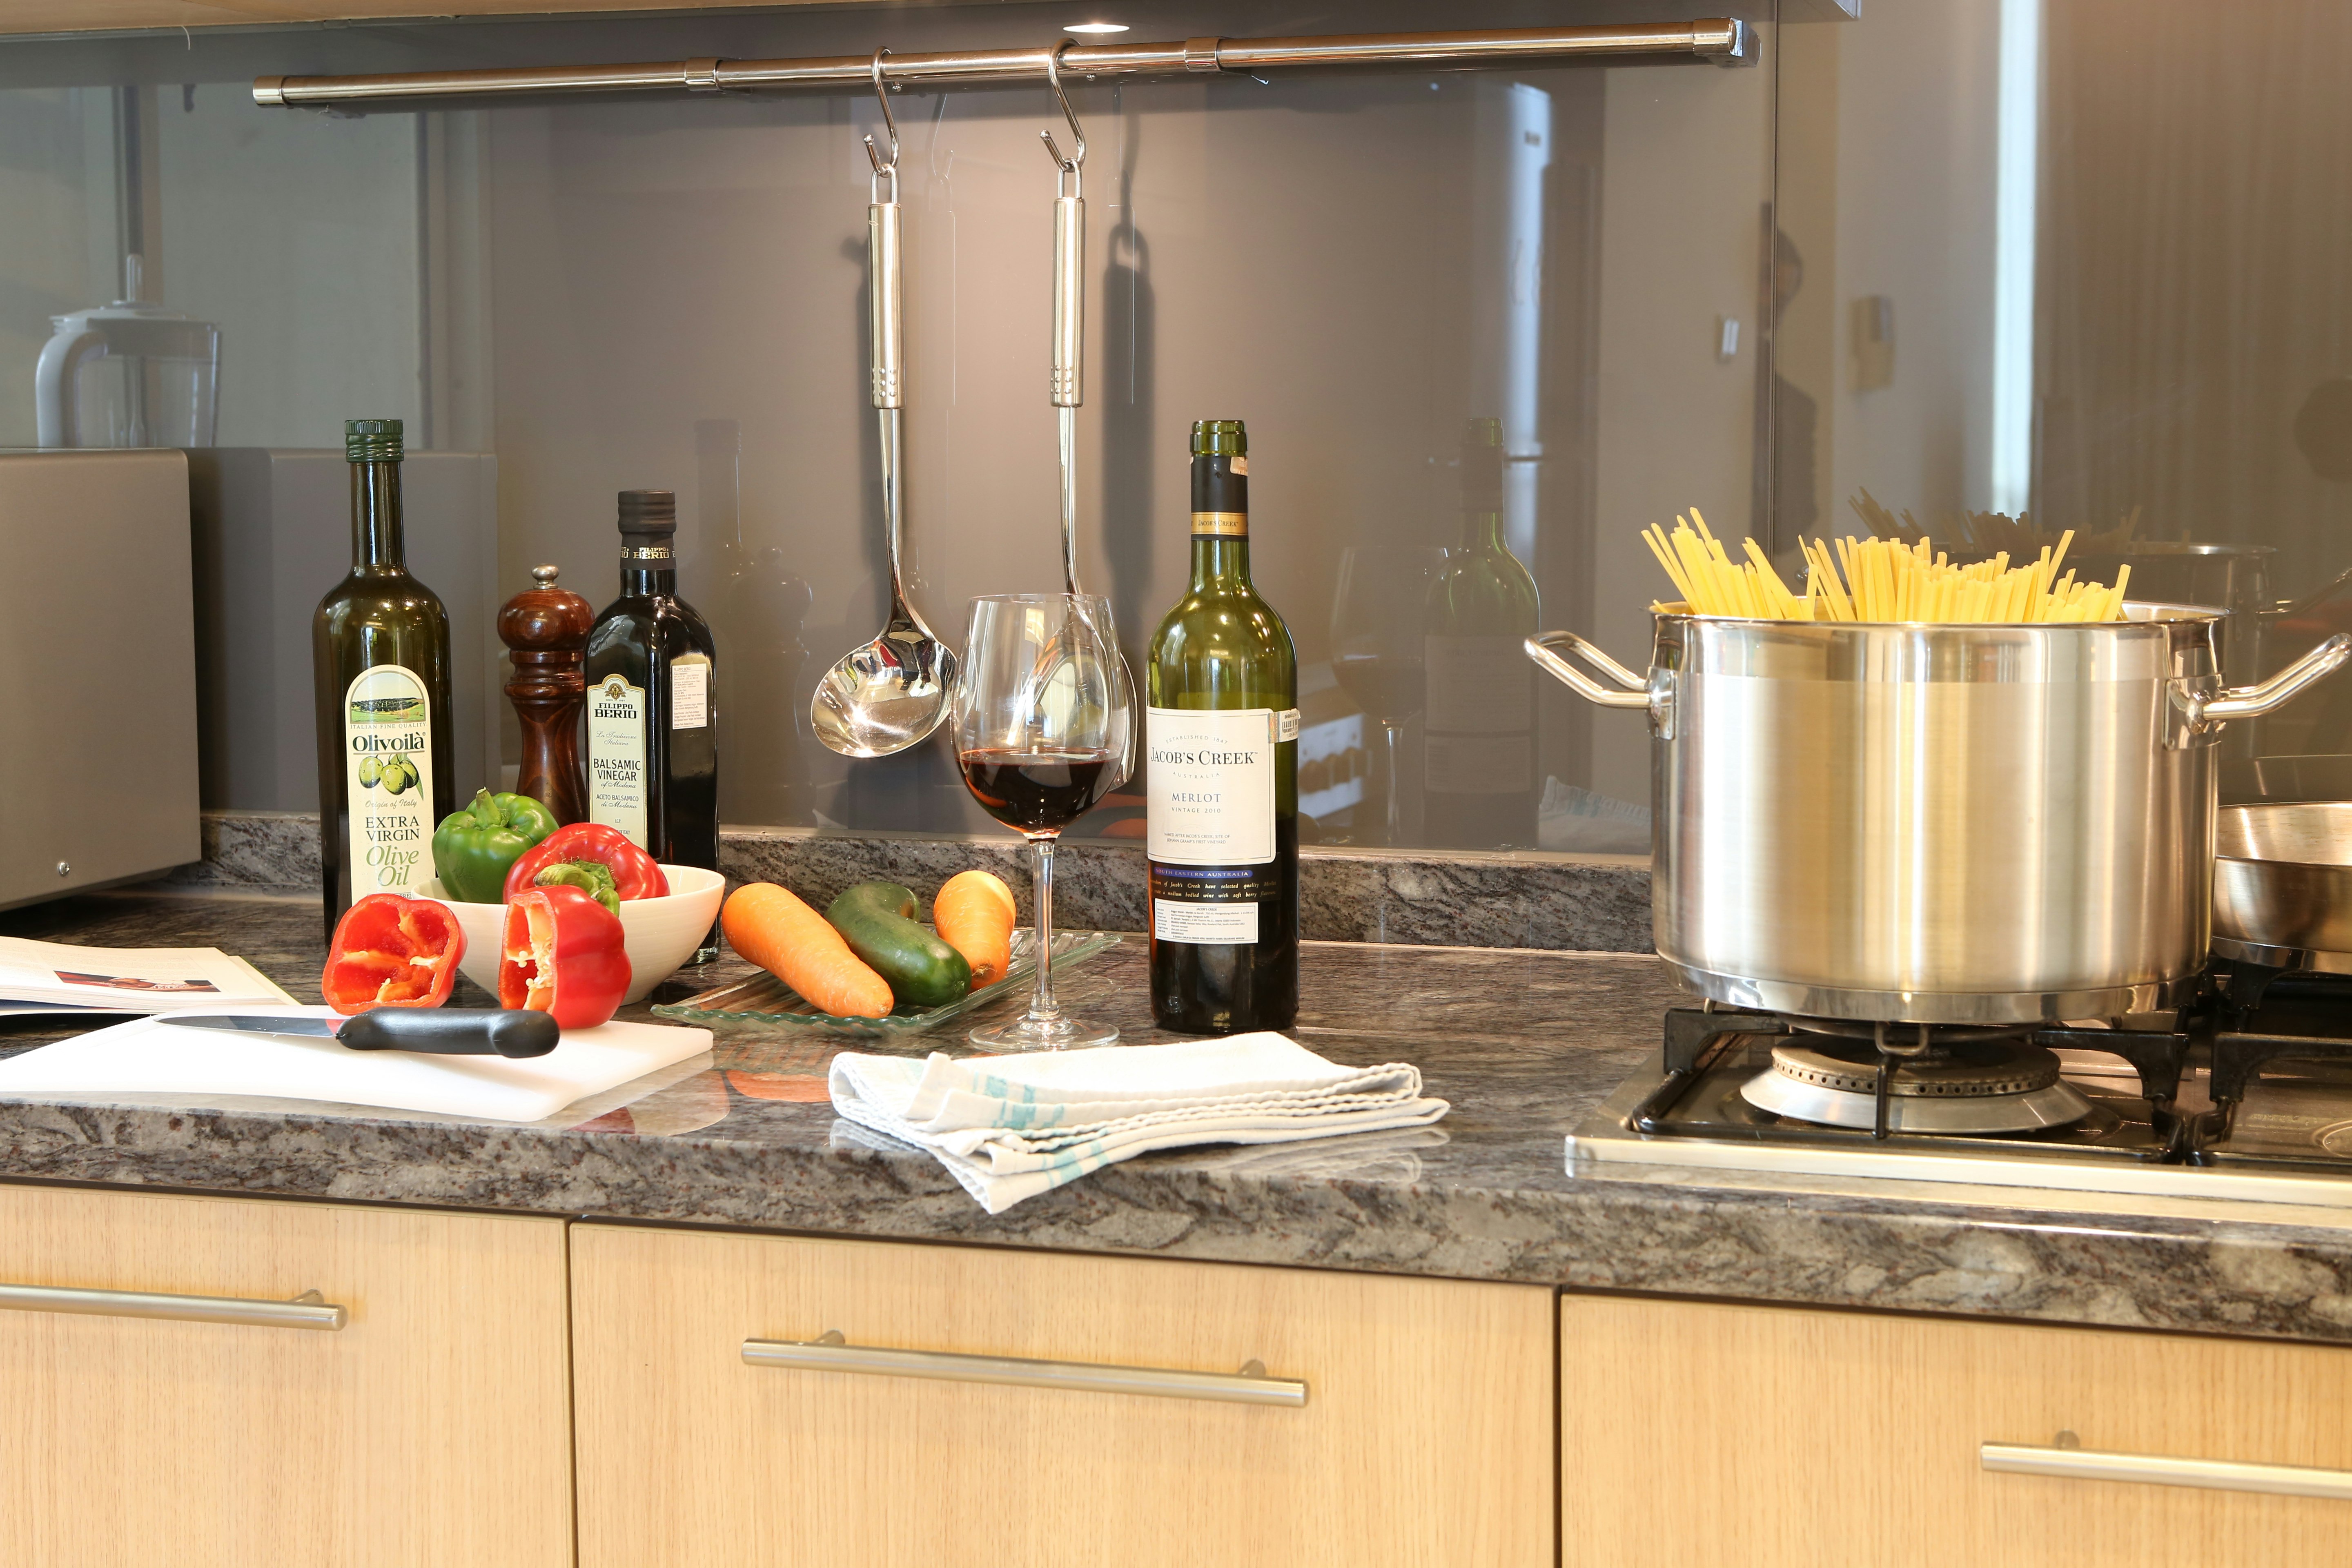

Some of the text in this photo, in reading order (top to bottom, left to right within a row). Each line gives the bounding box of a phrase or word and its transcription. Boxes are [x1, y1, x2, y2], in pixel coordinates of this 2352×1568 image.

[595, 709, 637, 719] BERIO
[352, 732, 425, 751] Olivoilà
[1166, 735, 1209, 744] ESTABLISHED
[1151, 747, 1194, 764] JACOB'S
[594, 758, 641, 770] BALSAMIC
[597, 770, 637, 781] VINEGAR
[601, 781, 609, 789] of
[1172, 793, 1221, 802] MERLOT
[365, 799, 417, 810] Origin of Italy
[365, 815, 419, 828] EXTRA
[366, 829, 420, 842] VIRGIN
[366, 845, 419, 866] Olive
[378, 865, 410, 886] Oil
